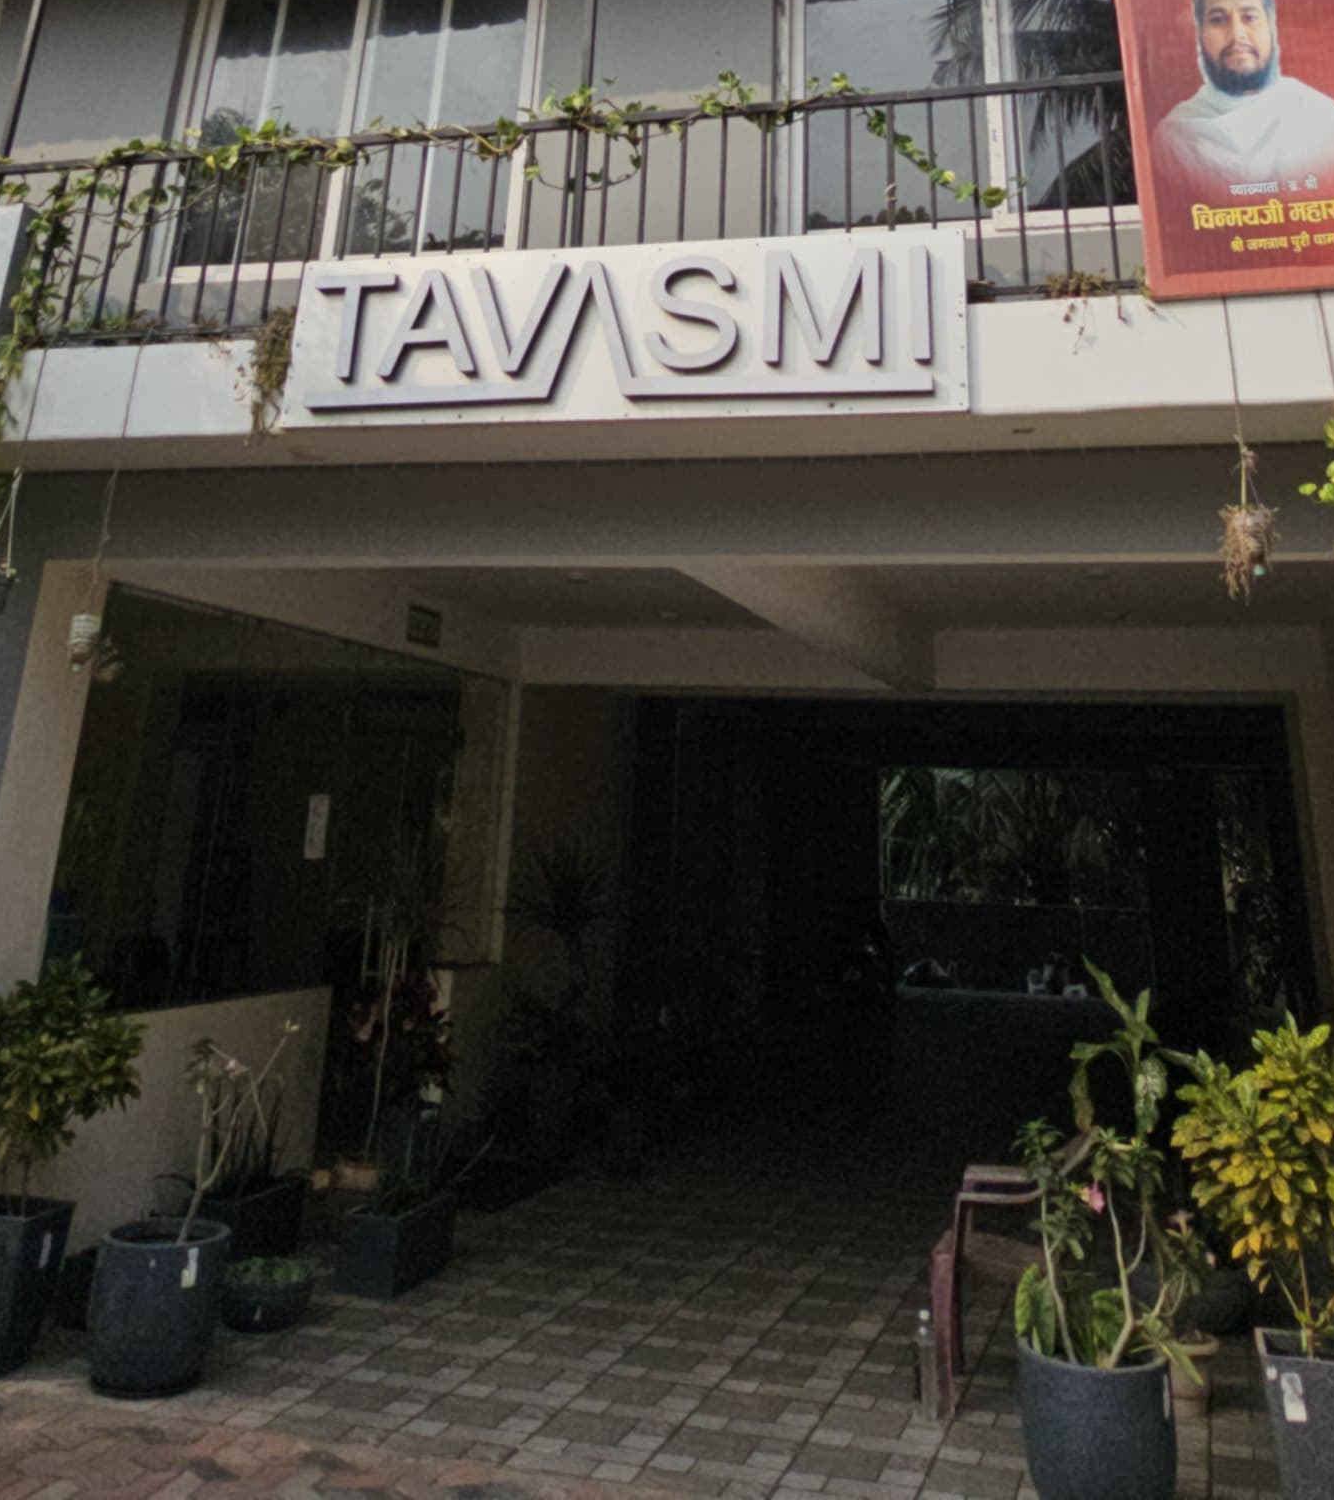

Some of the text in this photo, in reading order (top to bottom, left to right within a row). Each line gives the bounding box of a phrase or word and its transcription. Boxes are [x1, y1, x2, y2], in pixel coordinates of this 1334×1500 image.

[1191, 198, 1285, 230] चिन्मयजी
[1291, 231, 1310, 253] पुरी
[309, 245, 935, 408] TAVASMI
